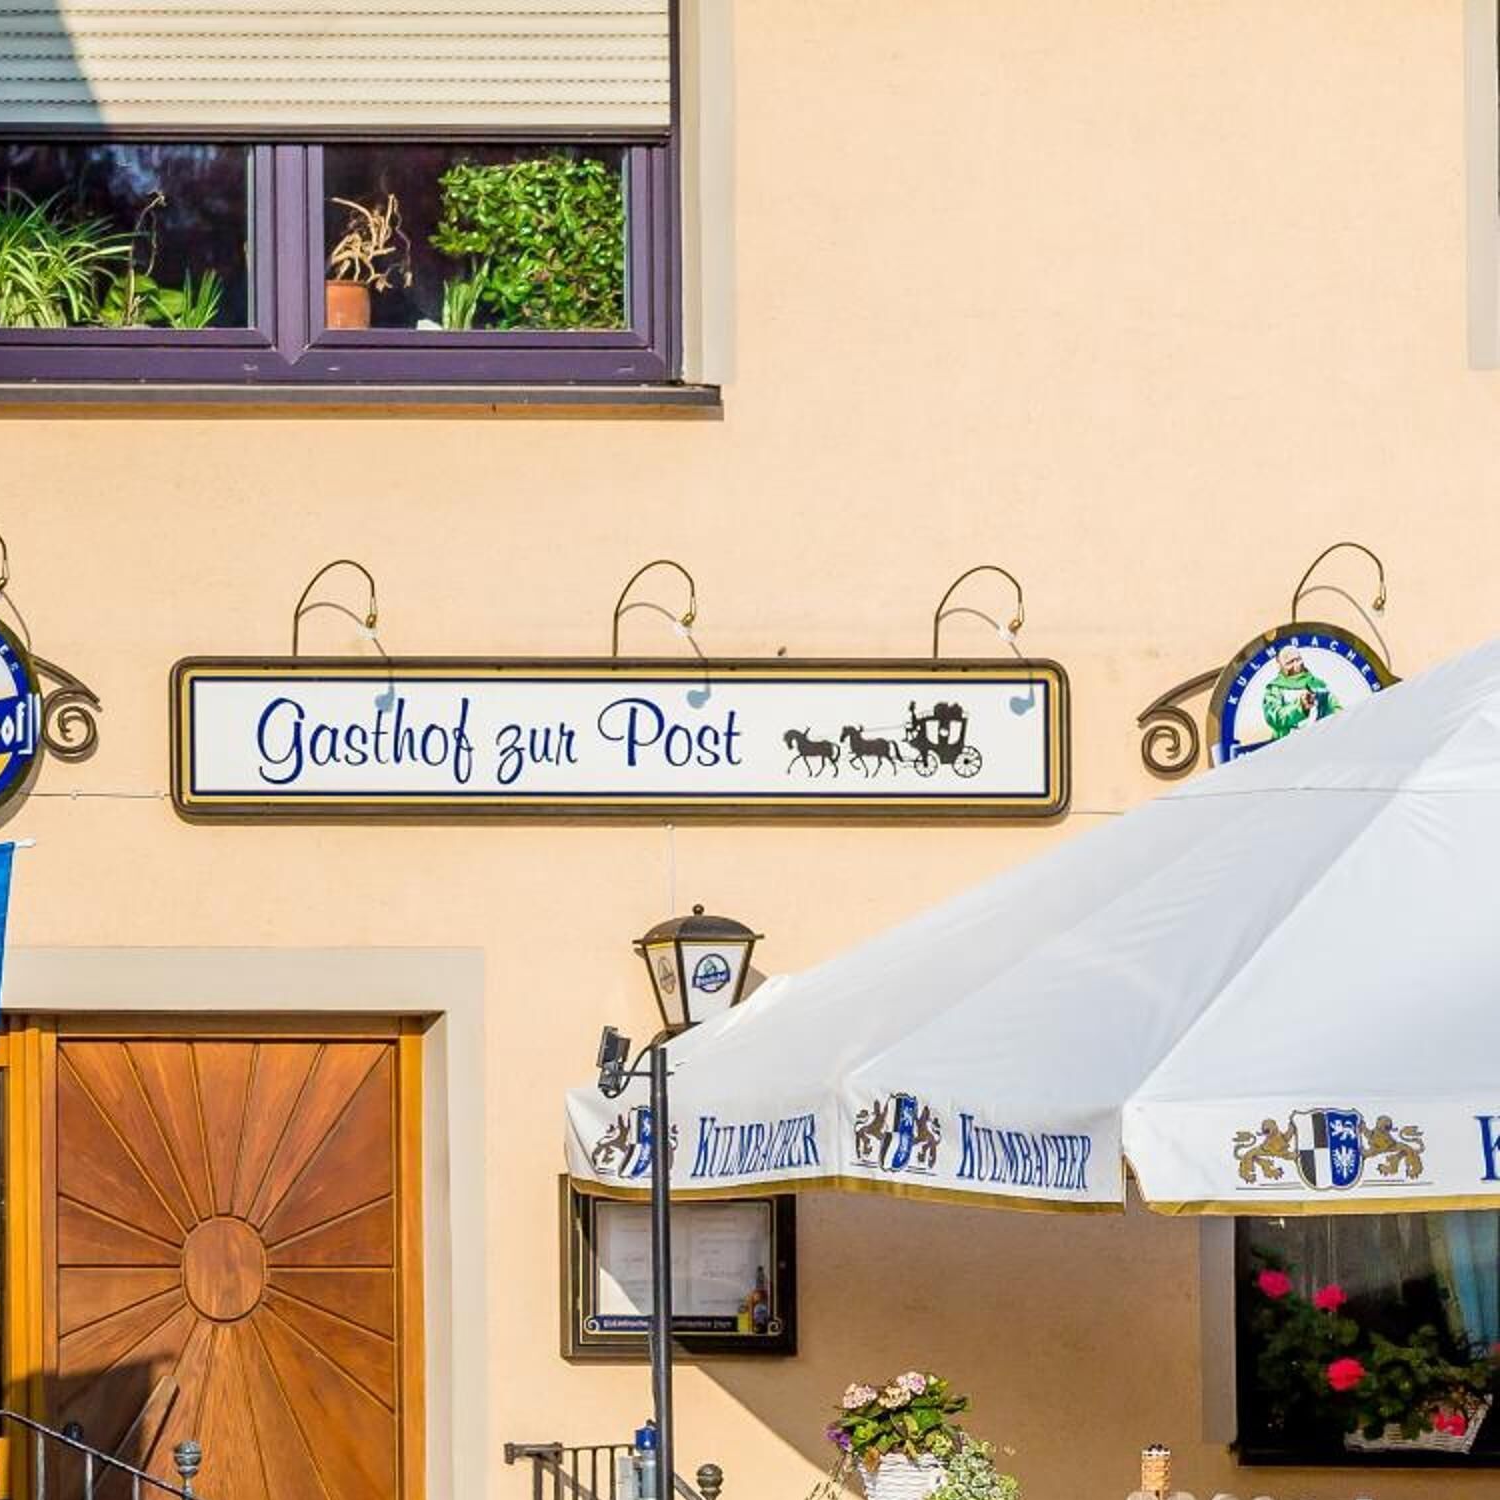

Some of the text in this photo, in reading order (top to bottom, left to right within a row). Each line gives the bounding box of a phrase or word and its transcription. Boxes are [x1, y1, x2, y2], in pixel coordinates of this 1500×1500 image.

[257, 695, 743, 785] Gasthof zur Post
[691, 1113, 822, 1179] KULMBACHER
[956, 1113, 1093, 1192] KULMBACHER
